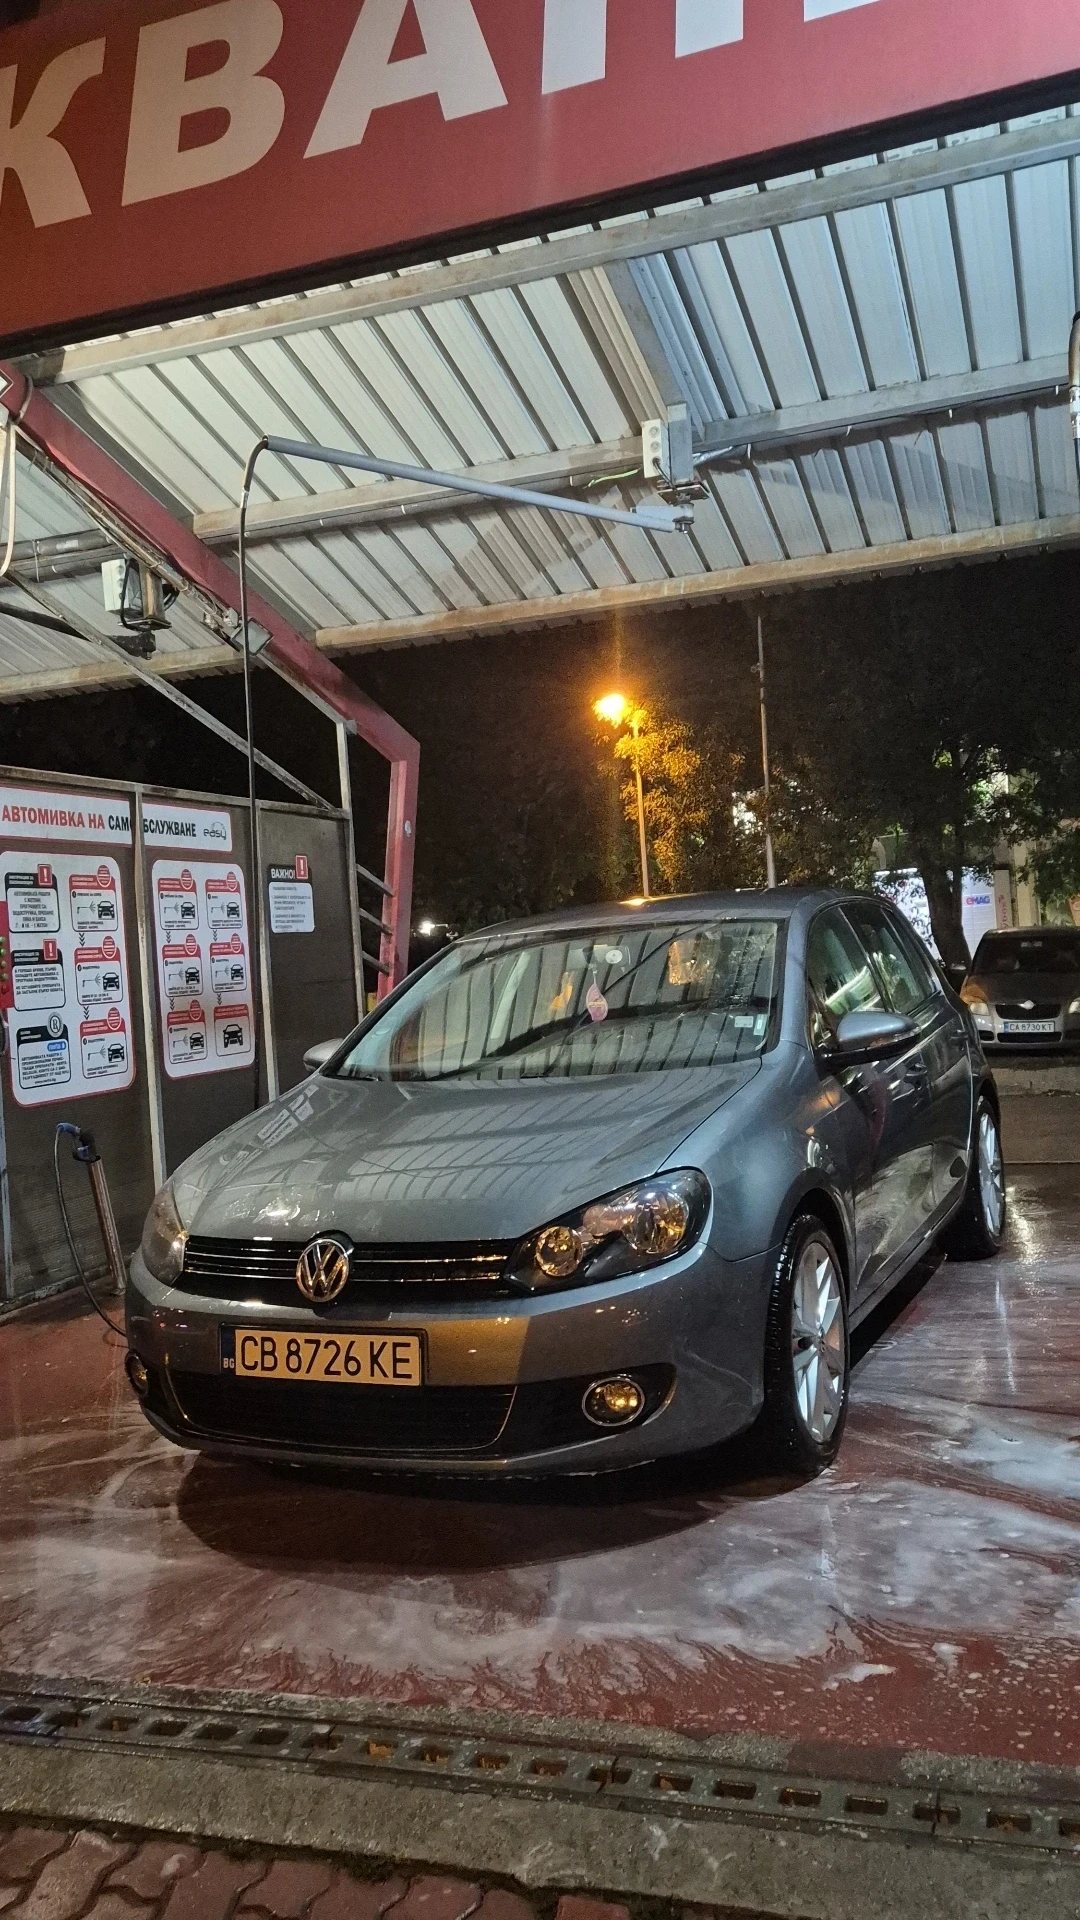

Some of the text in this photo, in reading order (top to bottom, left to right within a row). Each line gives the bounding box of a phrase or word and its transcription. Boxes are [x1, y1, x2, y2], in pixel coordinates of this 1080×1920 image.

[2, 805, 197, 837] АВТОМИВКА НА САМБСЛУЖВАНЕ
[223, 1358, 235, 1369] BG
[241, 1335, 413, 1379] CB 8726 KE
